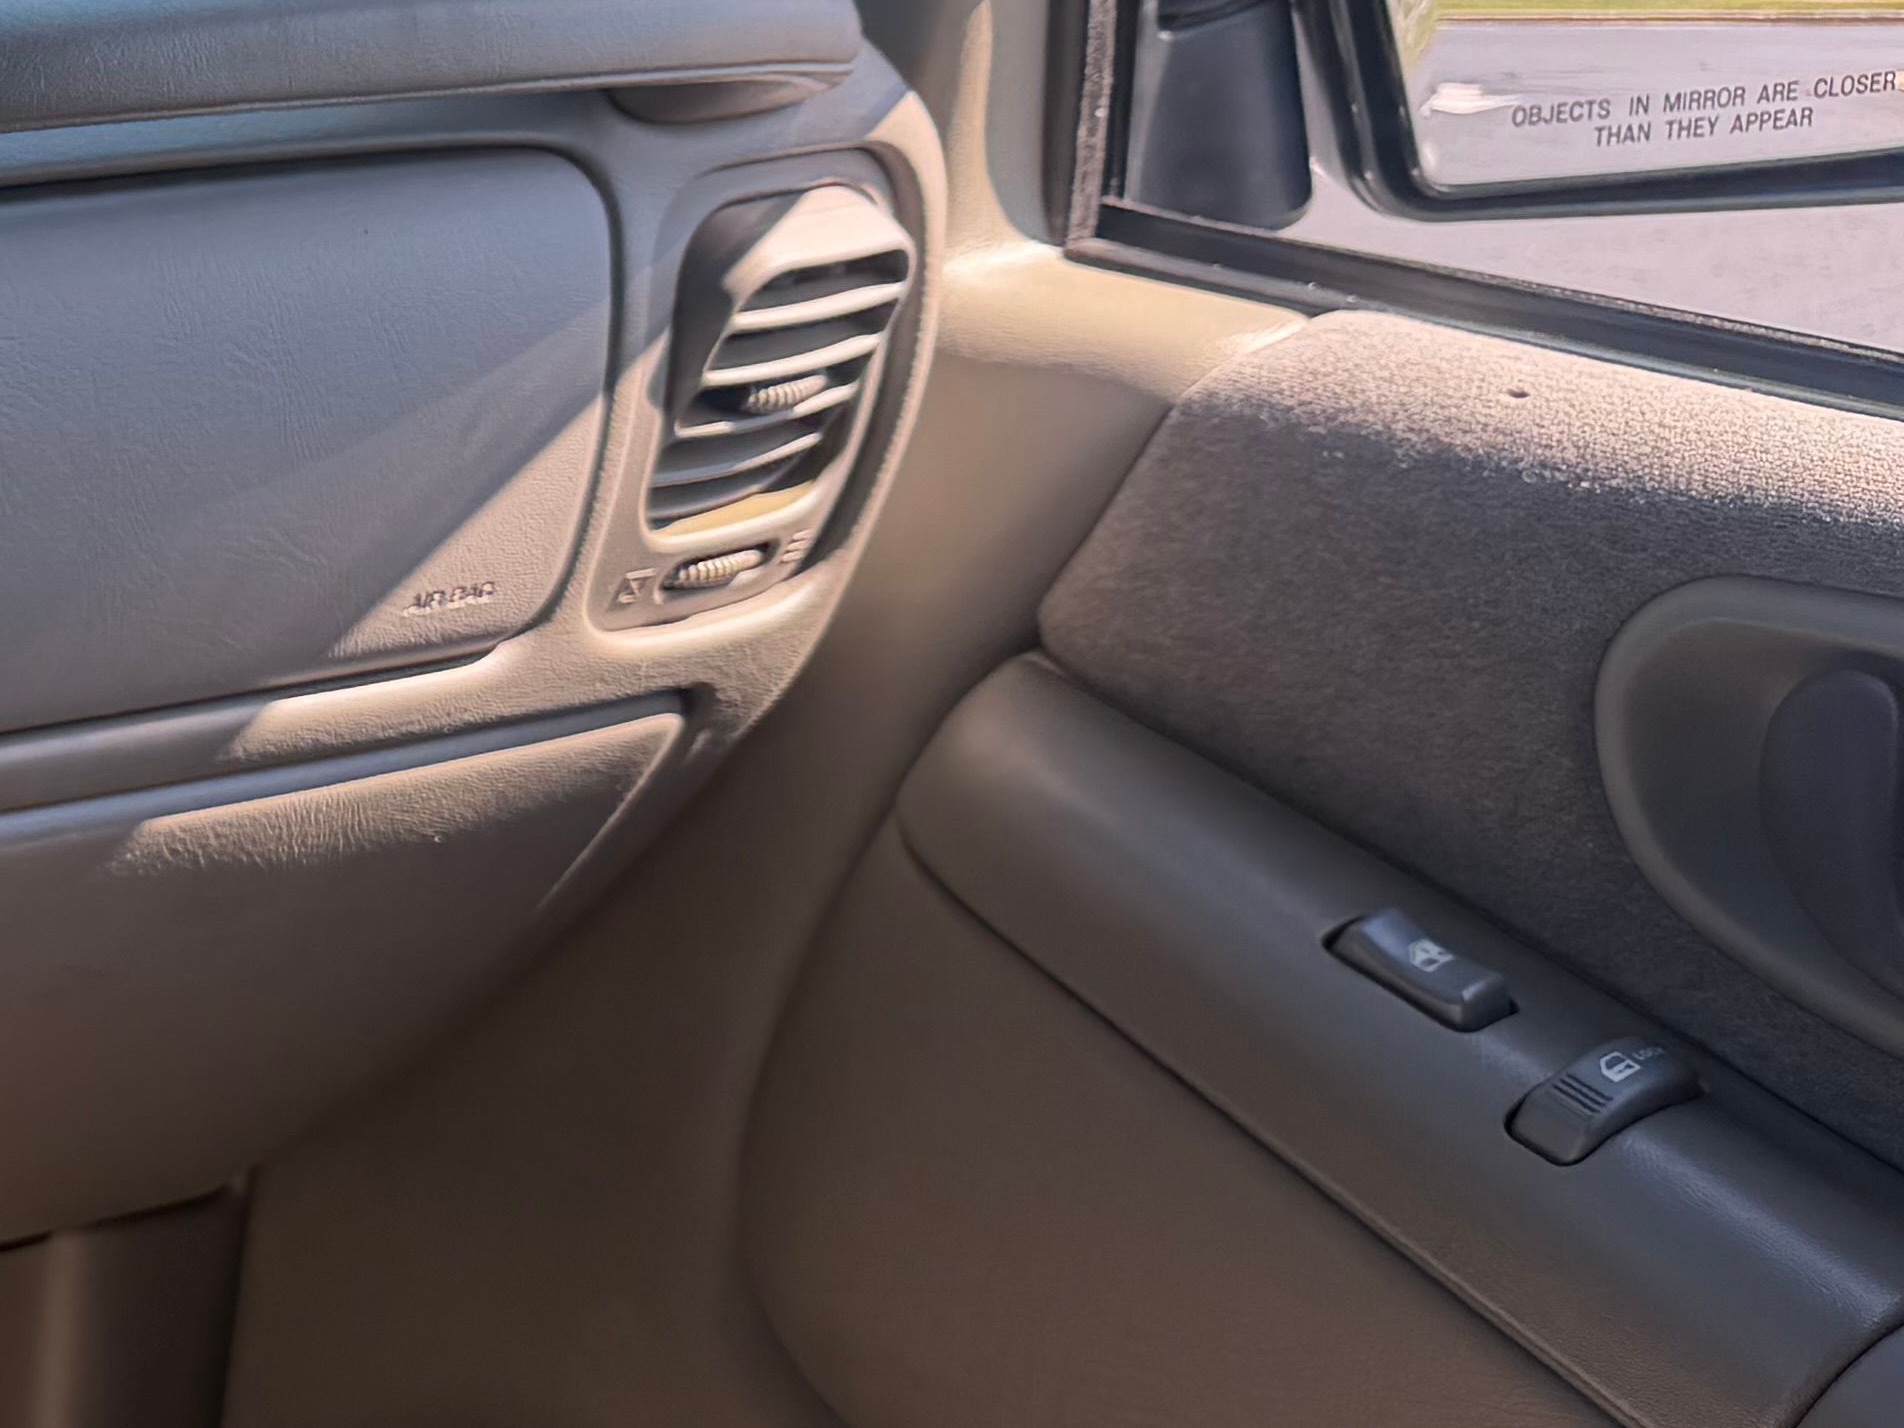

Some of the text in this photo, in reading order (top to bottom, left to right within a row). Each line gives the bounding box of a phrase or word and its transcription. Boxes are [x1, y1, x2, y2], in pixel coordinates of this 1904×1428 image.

[1512, 70, 1897, 128] OBJECTS IN MIRROR ARE CLOSER
[1594, 106, 1814, 147] THAN THEY APPEAR
